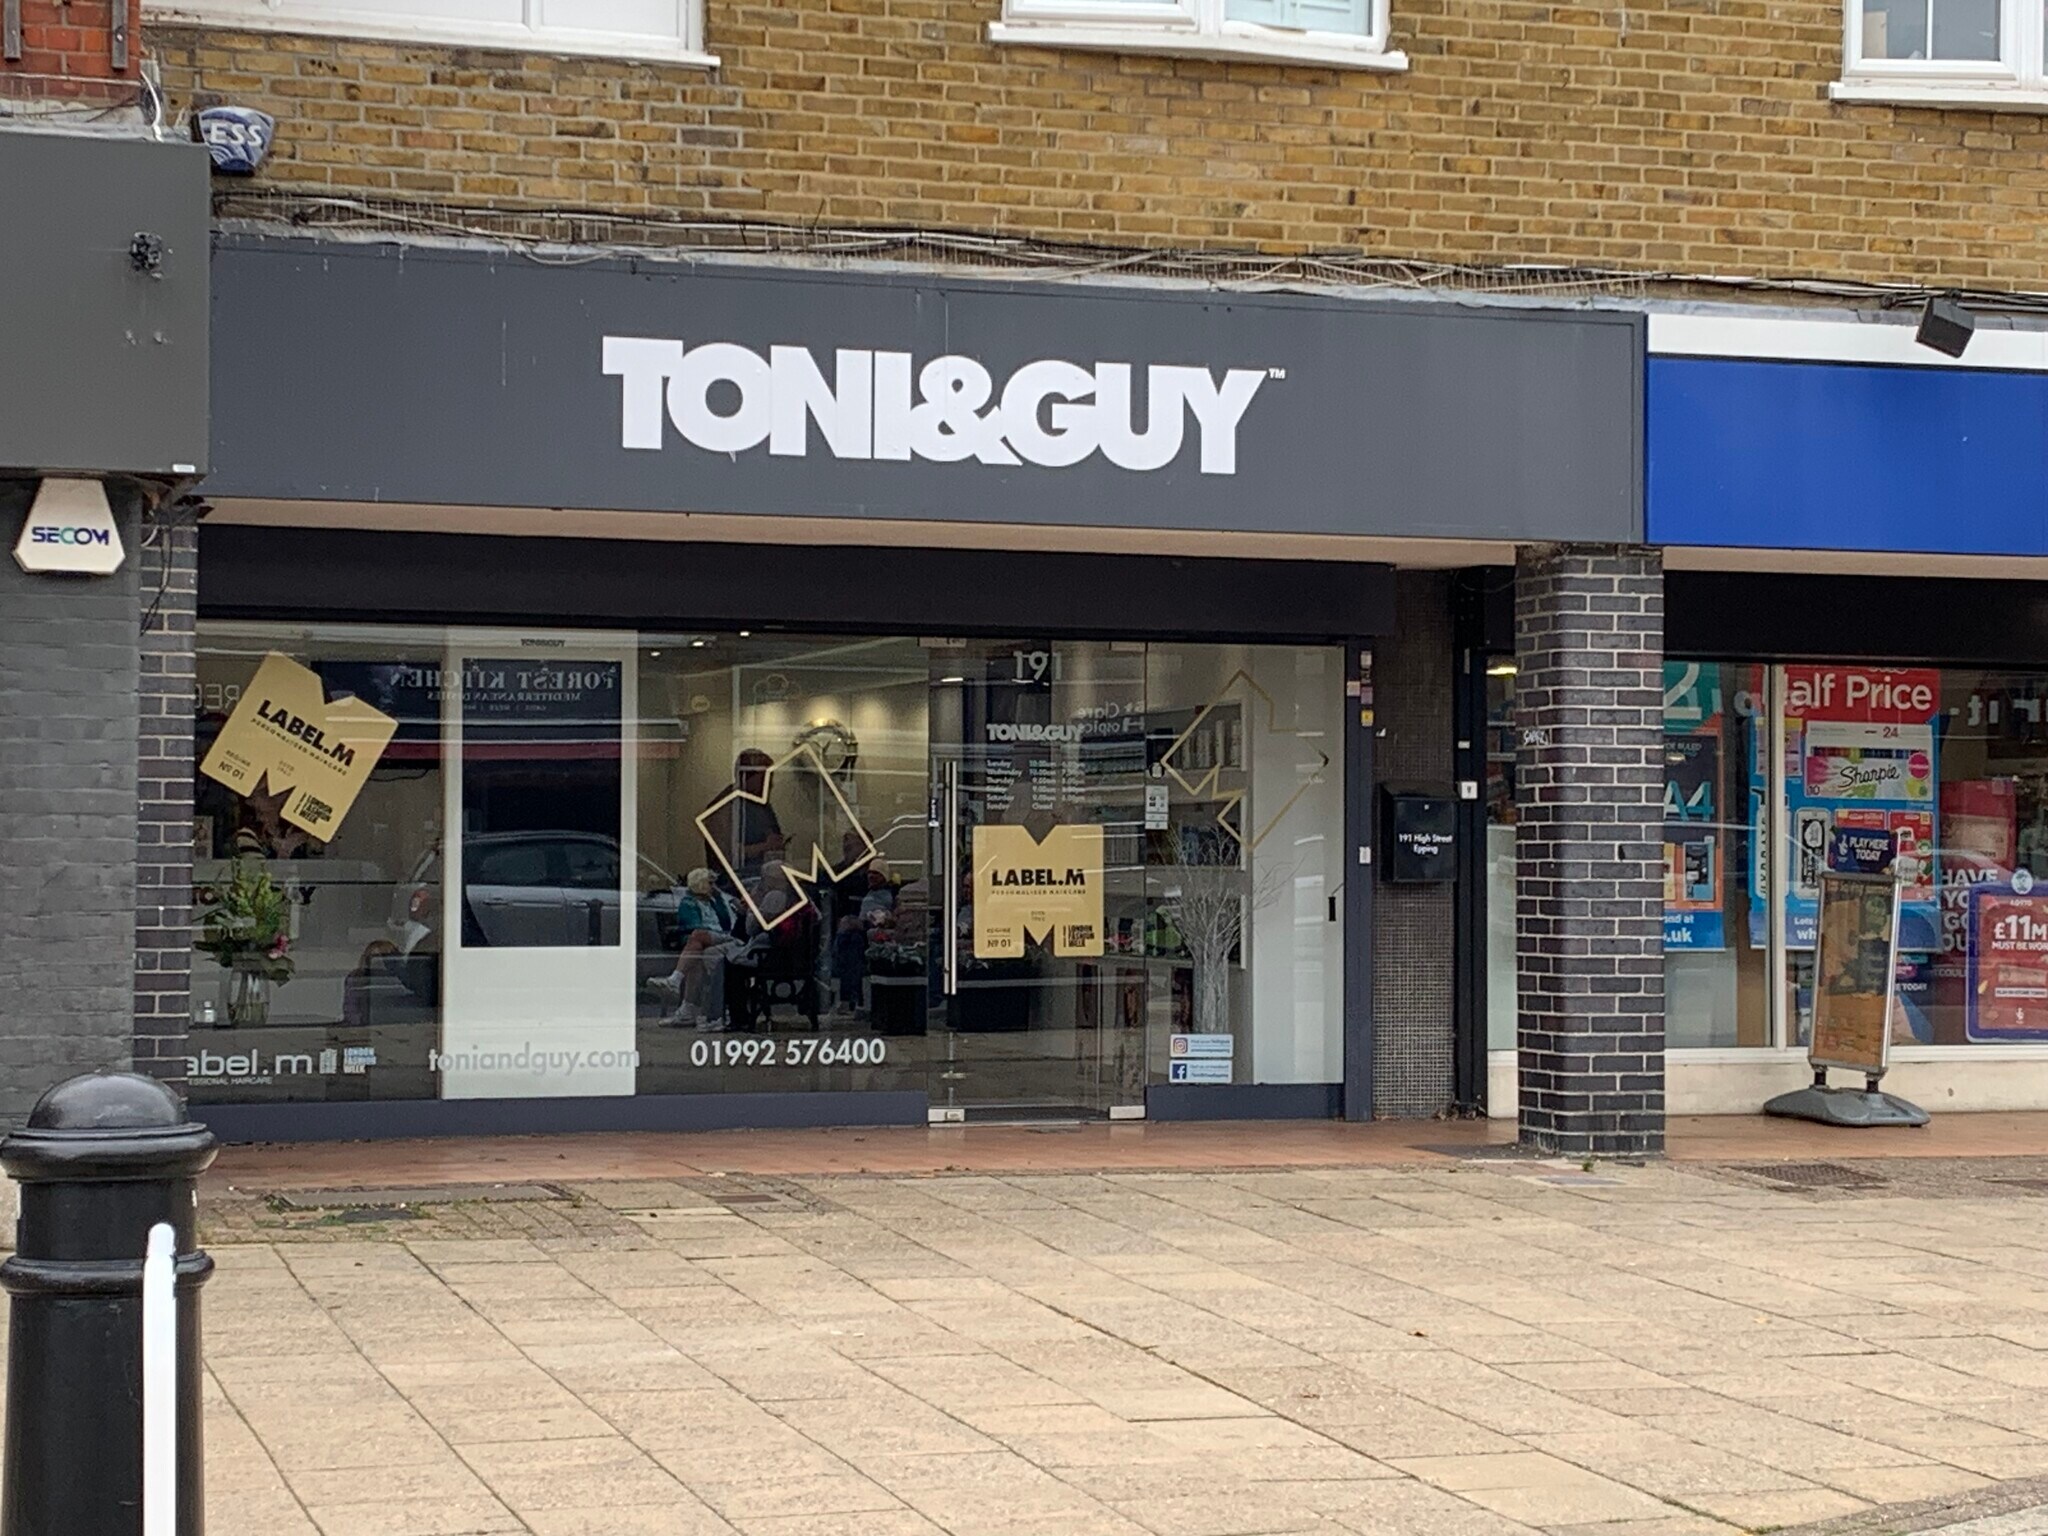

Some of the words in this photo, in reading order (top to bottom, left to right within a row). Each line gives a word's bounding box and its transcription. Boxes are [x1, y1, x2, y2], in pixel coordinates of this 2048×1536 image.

[209, 121, 263, 146] ESS
[602, 335, 1268, 475] TONI&GUY
[32, 526, 110, 547] SECOM
[1012, 651, 1062, 681] 191
[1846, 675, 1933, 711] Price
[256, 700, 356, 767] LABEL.M
[986, 723, 1083, 742] TONI&GUY
[1883, 726, 1899, 738] 24
[1840, 764, 1900, 788] Sharpie
[1808, 785, 1820, 795] 10
[1664, 781, 1715, 822] A4
[1399, 833, 1412, 842] 191
[1413, 833, 1431, 844] High
[1432, 833, 1453, 843] Street
[1849, 837, 1867, 848] PLAY
[1413, 843, 1439, 854] Epping
[1855, 848, 1881, 861] TODAY
[991, 869, 1086, 886] LABEL.M
[1794, 917, 1814, 926] Lots
[1000, 939, 1011, 948] 01
[1797, 929, 1817, 940] wh
[1991, 941, 2015, 950] MUST
[2016, 942, 2028, 950] BE
[429, 1042, 640, 1076] toniandguy.com
[690, 1040, 776, 1067] 01992
[784, 1038, 886, 1065] 576400
